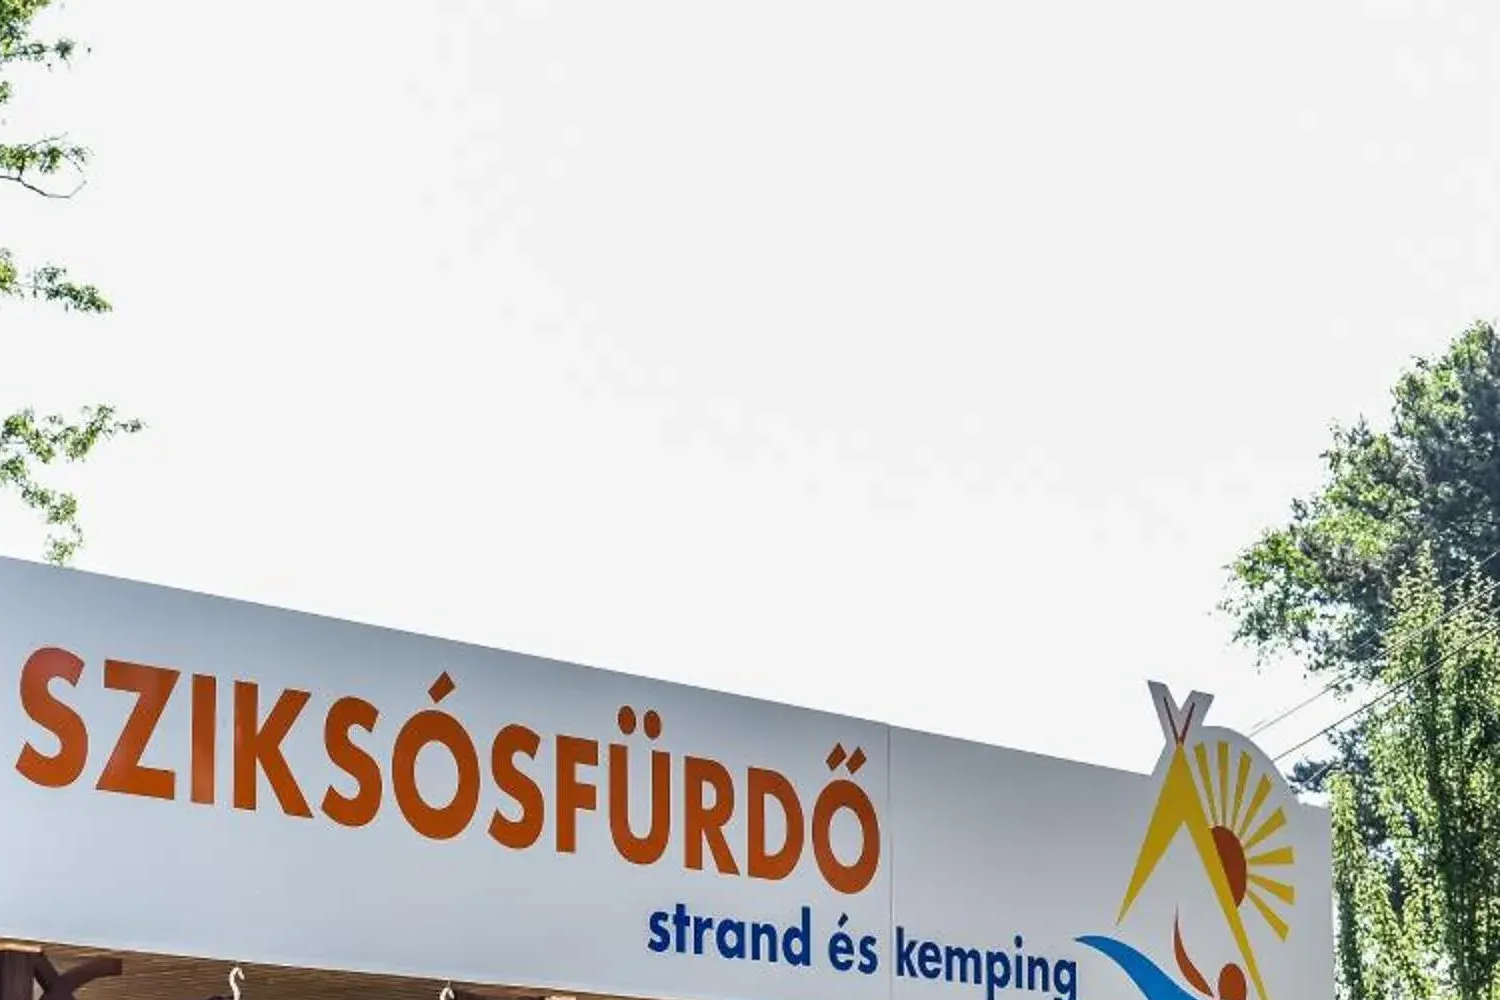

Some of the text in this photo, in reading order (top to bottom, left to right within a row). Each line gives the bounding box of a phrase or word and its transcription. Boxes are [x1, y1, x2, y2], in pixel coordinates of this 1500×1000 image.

[14, 646, 881, 895] SZIKSÓSFÜRDŐ
[647, 902, 812, 968] strand
[827, 912, 880, 977] és
